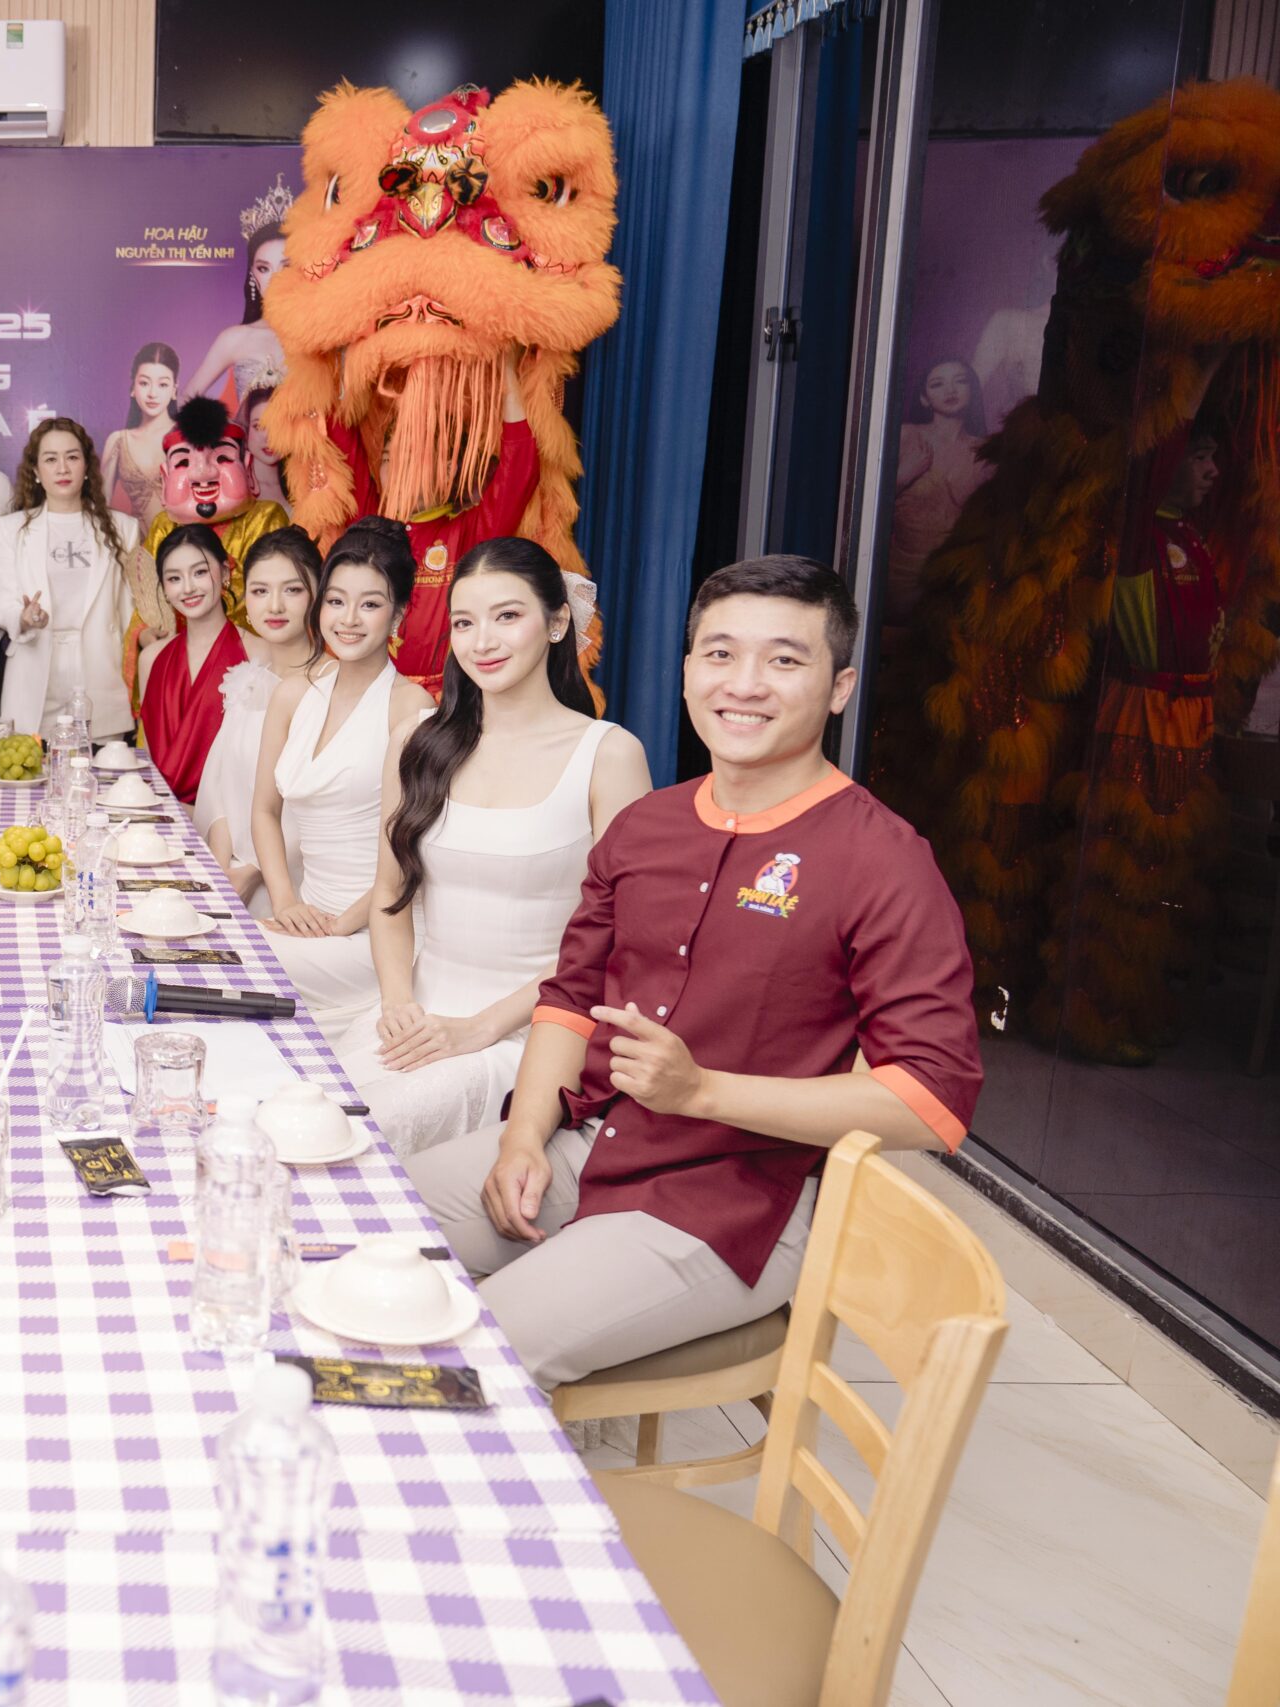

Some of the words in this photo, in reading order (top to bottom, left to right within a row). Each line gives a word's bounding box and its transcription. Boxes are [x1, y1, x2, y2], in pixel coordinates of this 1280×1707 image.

[144, 227, 175, 241] HOA
[177, 225, 208, 243] HẬU
[168, 247, 187, 261] THỊ
[188, 244, 213, 259] YẾN
[213, 247, 235, 259] NHI
